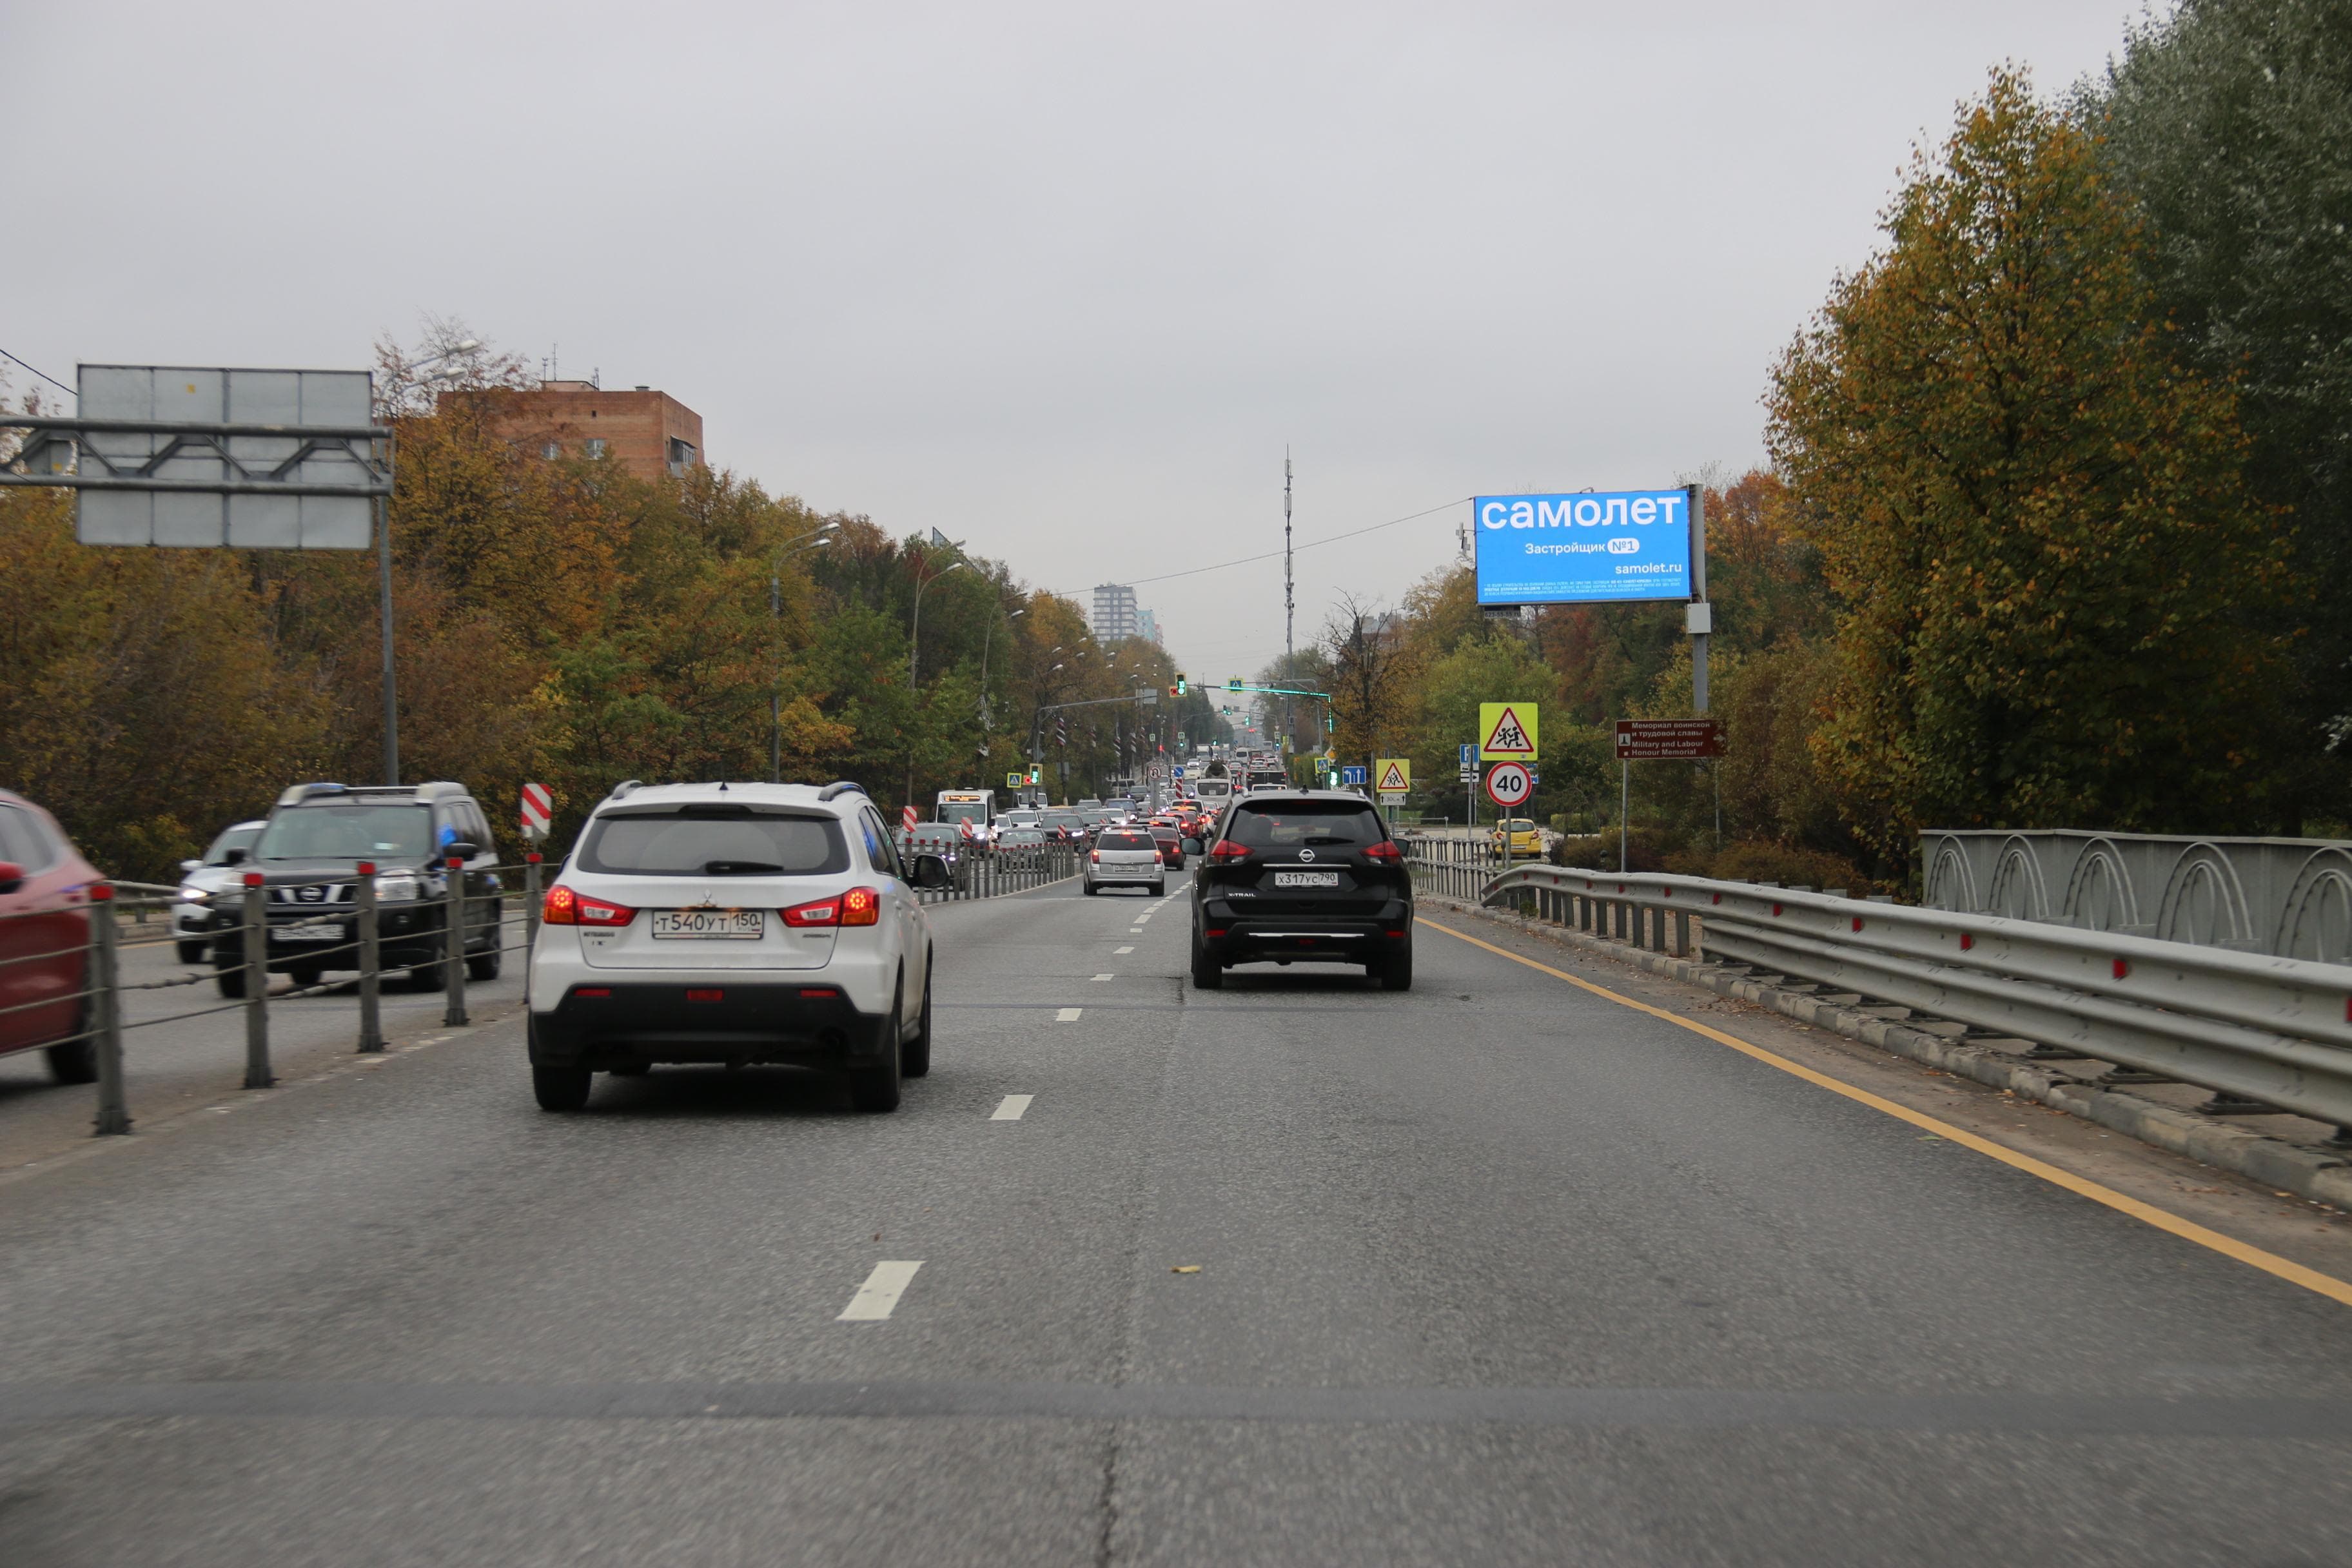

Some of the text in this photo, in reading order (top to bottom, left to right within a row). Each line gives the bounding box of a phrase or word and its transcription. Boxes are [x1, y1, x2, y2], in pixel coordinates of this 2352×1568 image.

[1482, 496, 1681, 530] самолет
[1525, 540, 1635, 556] Застройщик №1
[1615, 562, 1682, 574] samolet.ru
[1496, 775, 1522, 792] 40
[660, 913, 758, 931] Т540УТ 150
